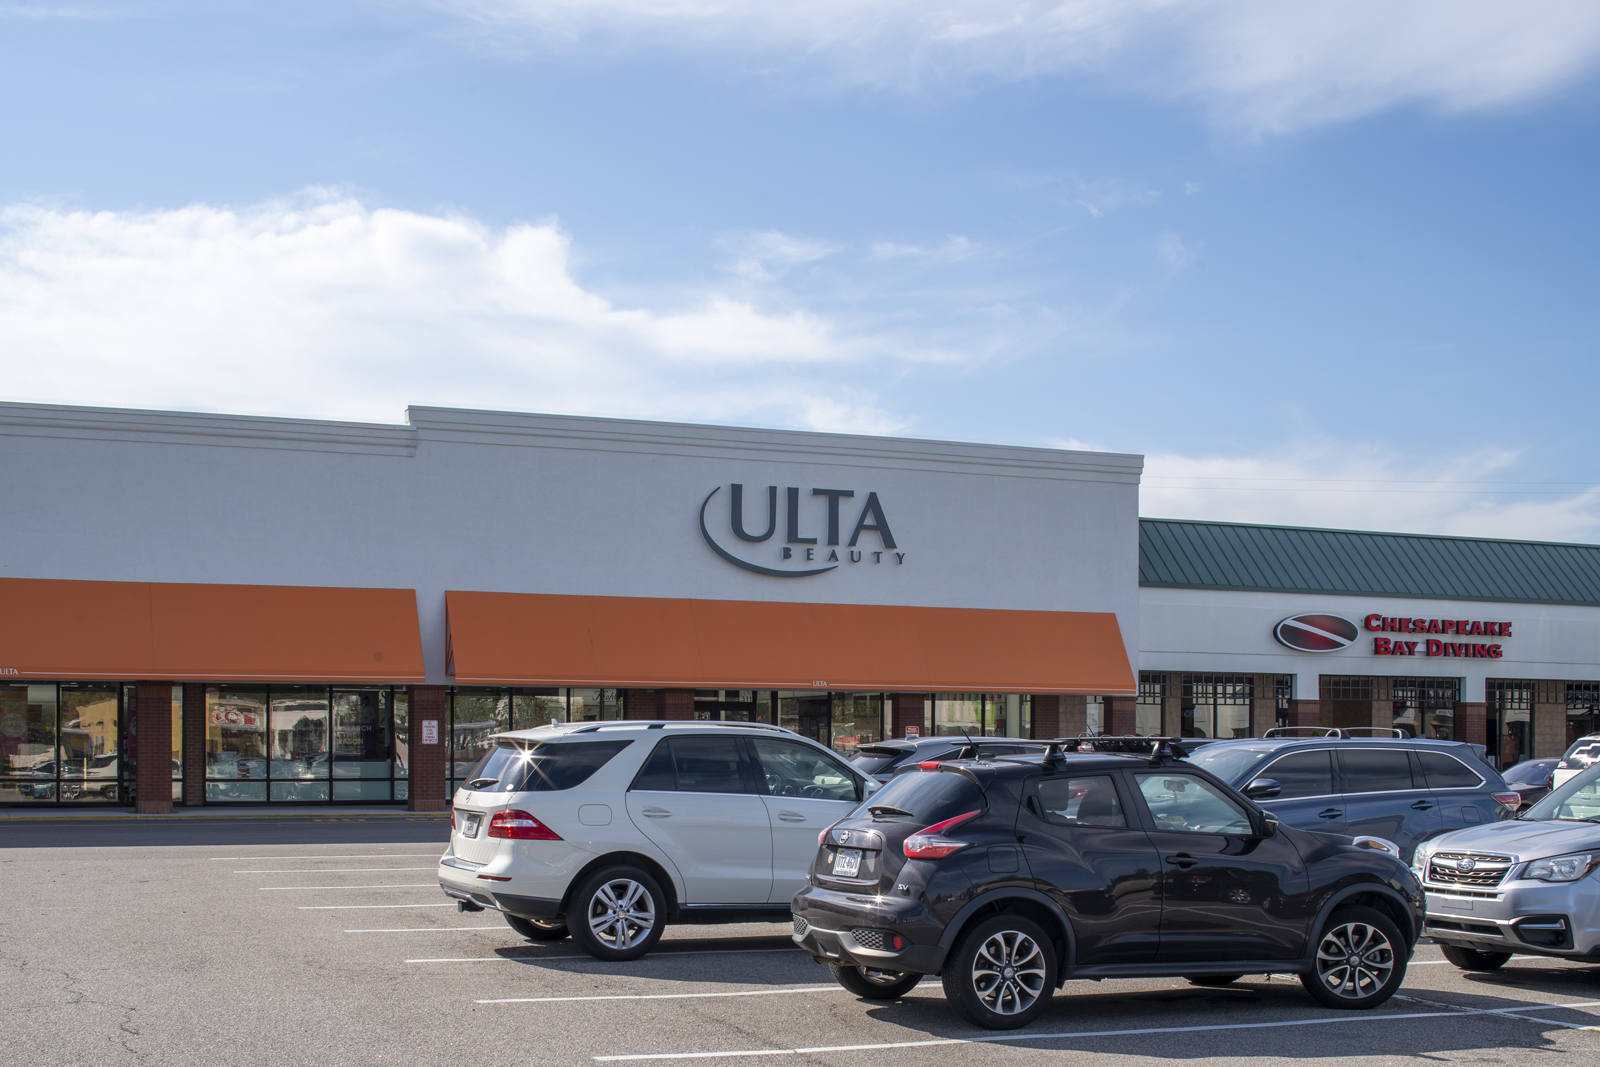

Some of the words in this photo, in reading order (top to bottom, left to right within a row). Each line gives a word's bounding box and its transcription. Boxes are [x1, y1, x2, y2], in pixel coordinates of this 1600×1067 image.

[730, 483, 897, 549] ULTA
[782, 547, 906, 565] BEAUTY
[1364, 613, 1512, 637] CHESAPEAKE
[1374, 637, 1419, 656] BAY
[1425, 639, 1504, 658] DIVING
[0, 667, 19, 675] ULTA
